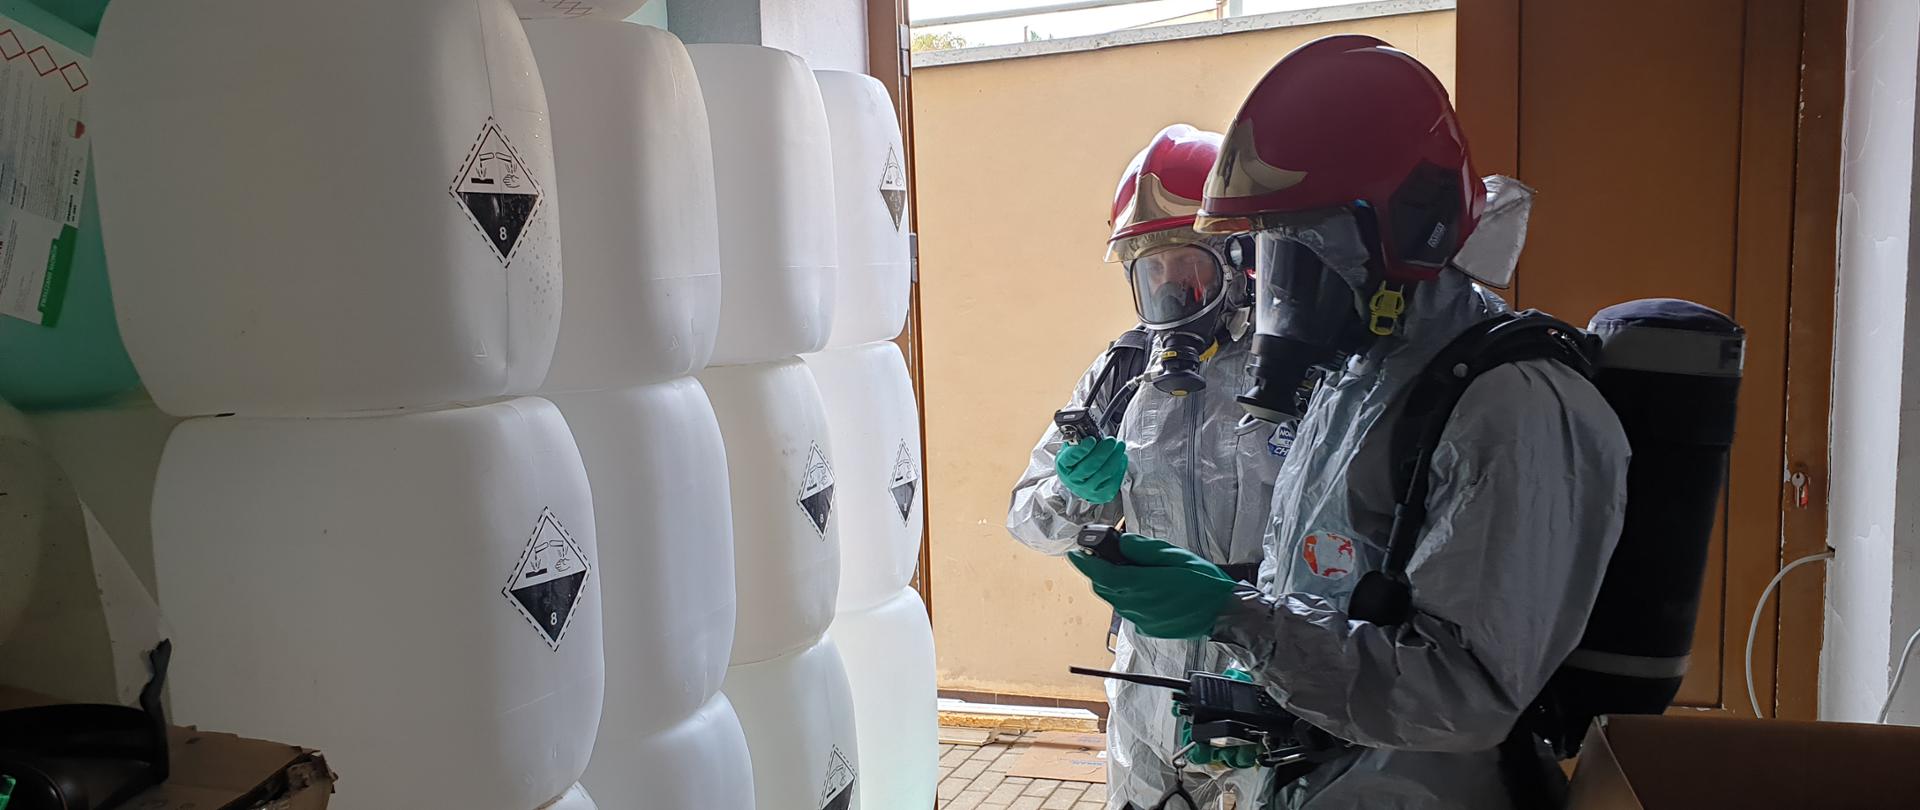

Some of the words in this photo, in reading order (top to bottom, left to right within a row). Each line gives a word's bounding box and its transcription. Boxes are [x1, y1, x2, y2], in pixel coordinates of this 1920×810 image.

[500, 226, 507, 240] 8
[1273, 447, 1290, 456] CH
[550, 611, 557, 625] 8
